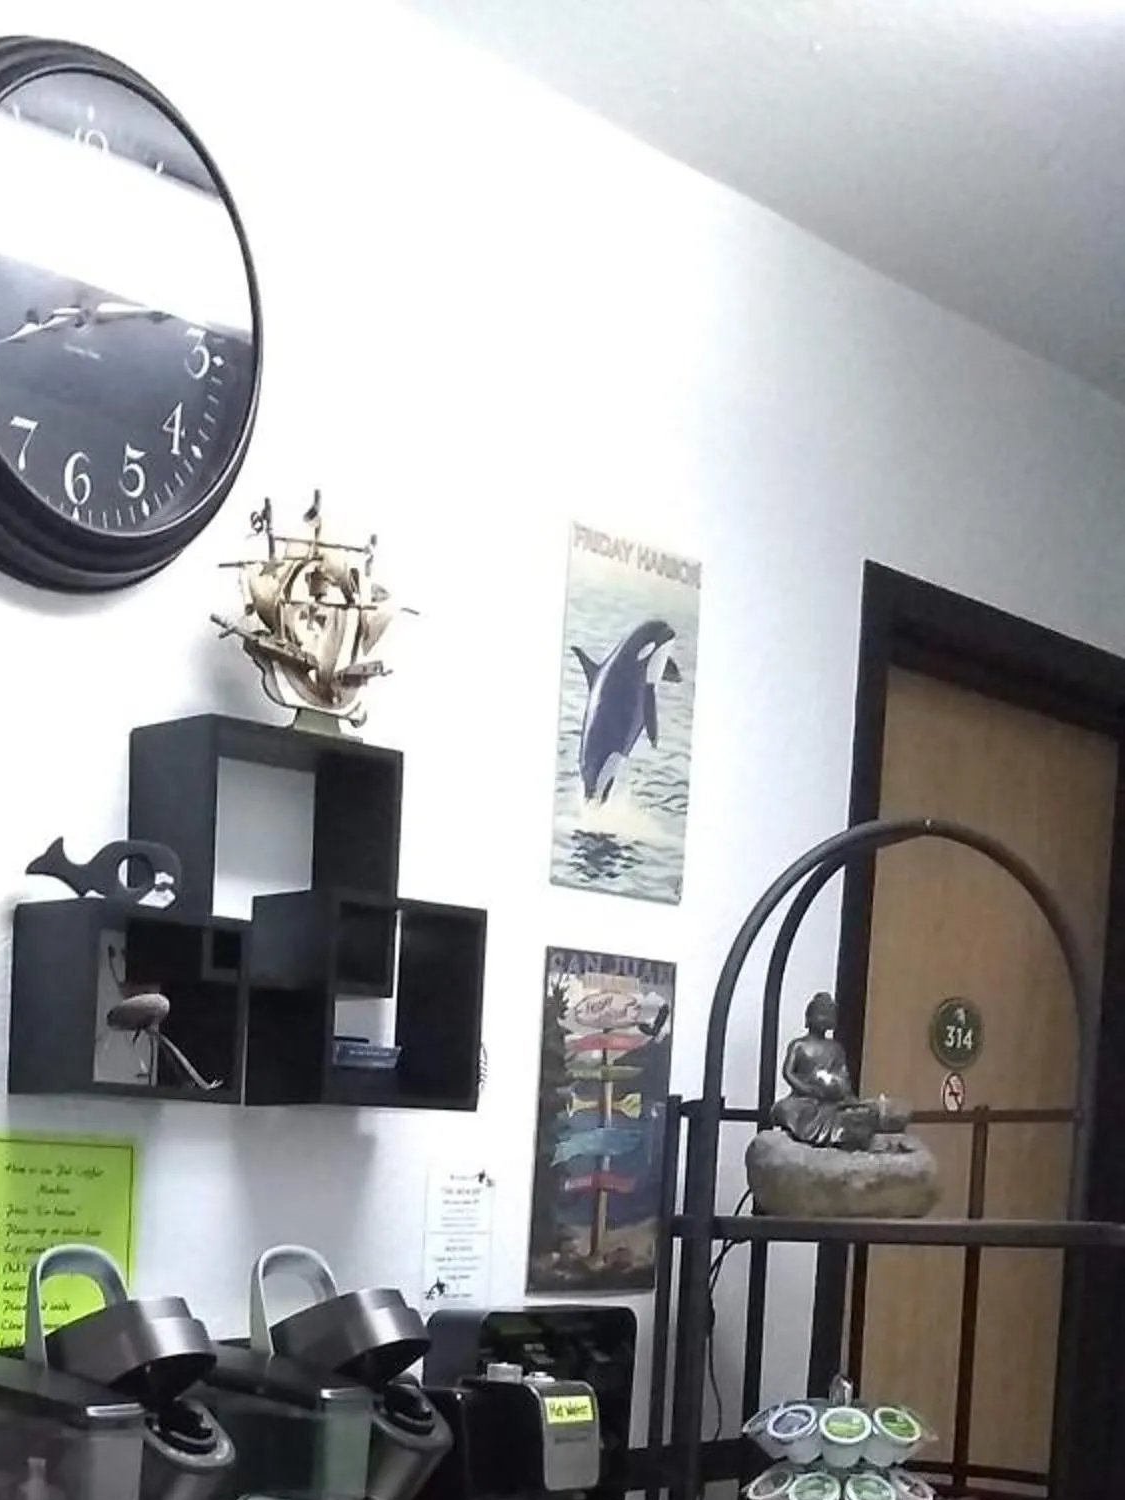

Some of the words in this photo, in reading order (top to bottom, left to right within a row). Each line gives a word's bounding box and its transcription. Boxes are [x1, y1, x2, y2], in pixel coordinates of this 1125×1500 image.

[184, 327, 210, 379] 3
[10, 416, 38, 471] 7
[162, 401, 186, 455] 4
[64, 451, 92, 505] 6
[118, 443, 146, 497] 5
[944, 1025, 973, 1050] 314
